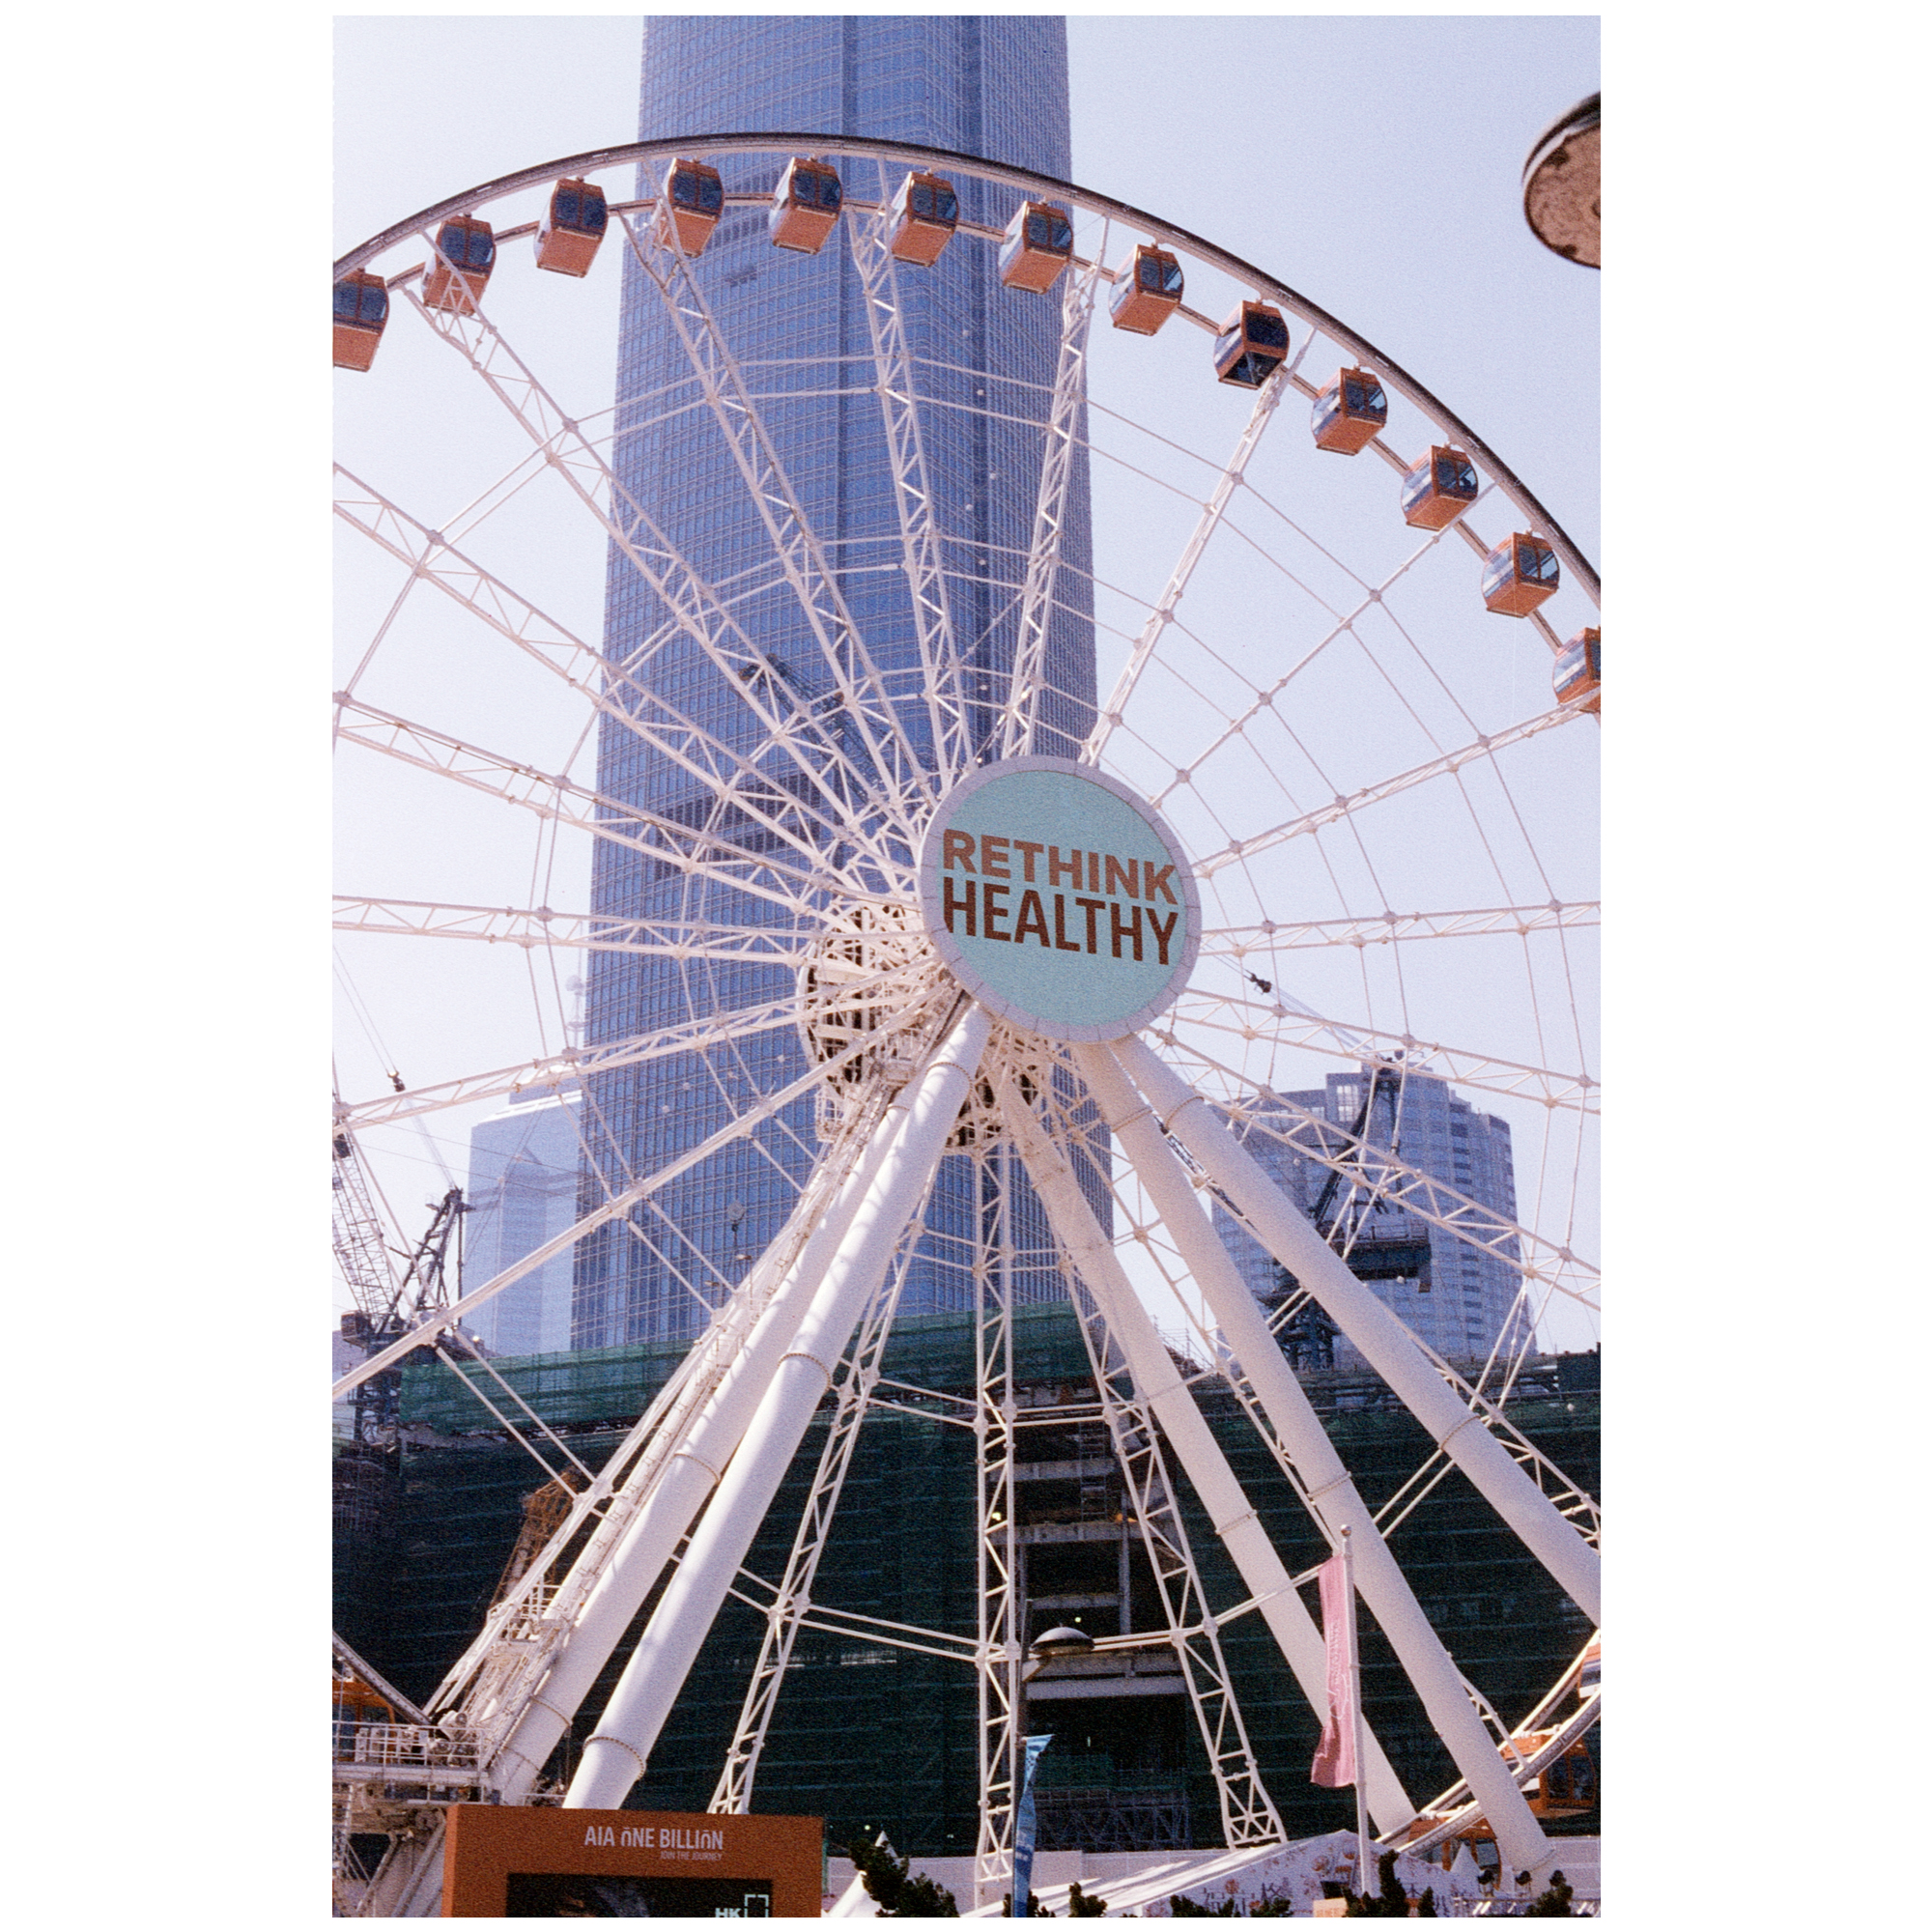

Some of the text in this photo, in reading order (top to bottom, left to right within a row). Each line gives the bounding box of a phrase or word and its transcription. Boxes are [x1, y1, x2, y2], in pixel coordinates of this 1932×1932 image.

[943, 828, 1178, 906] RETHINK
[943, 876, 1179, 966] HEALTHY
[584, 1826, 615, 1847] AIA
[660, 1851, 675, 1860] JOIN
[692, 1852, 723, 1861] JOURNEY
